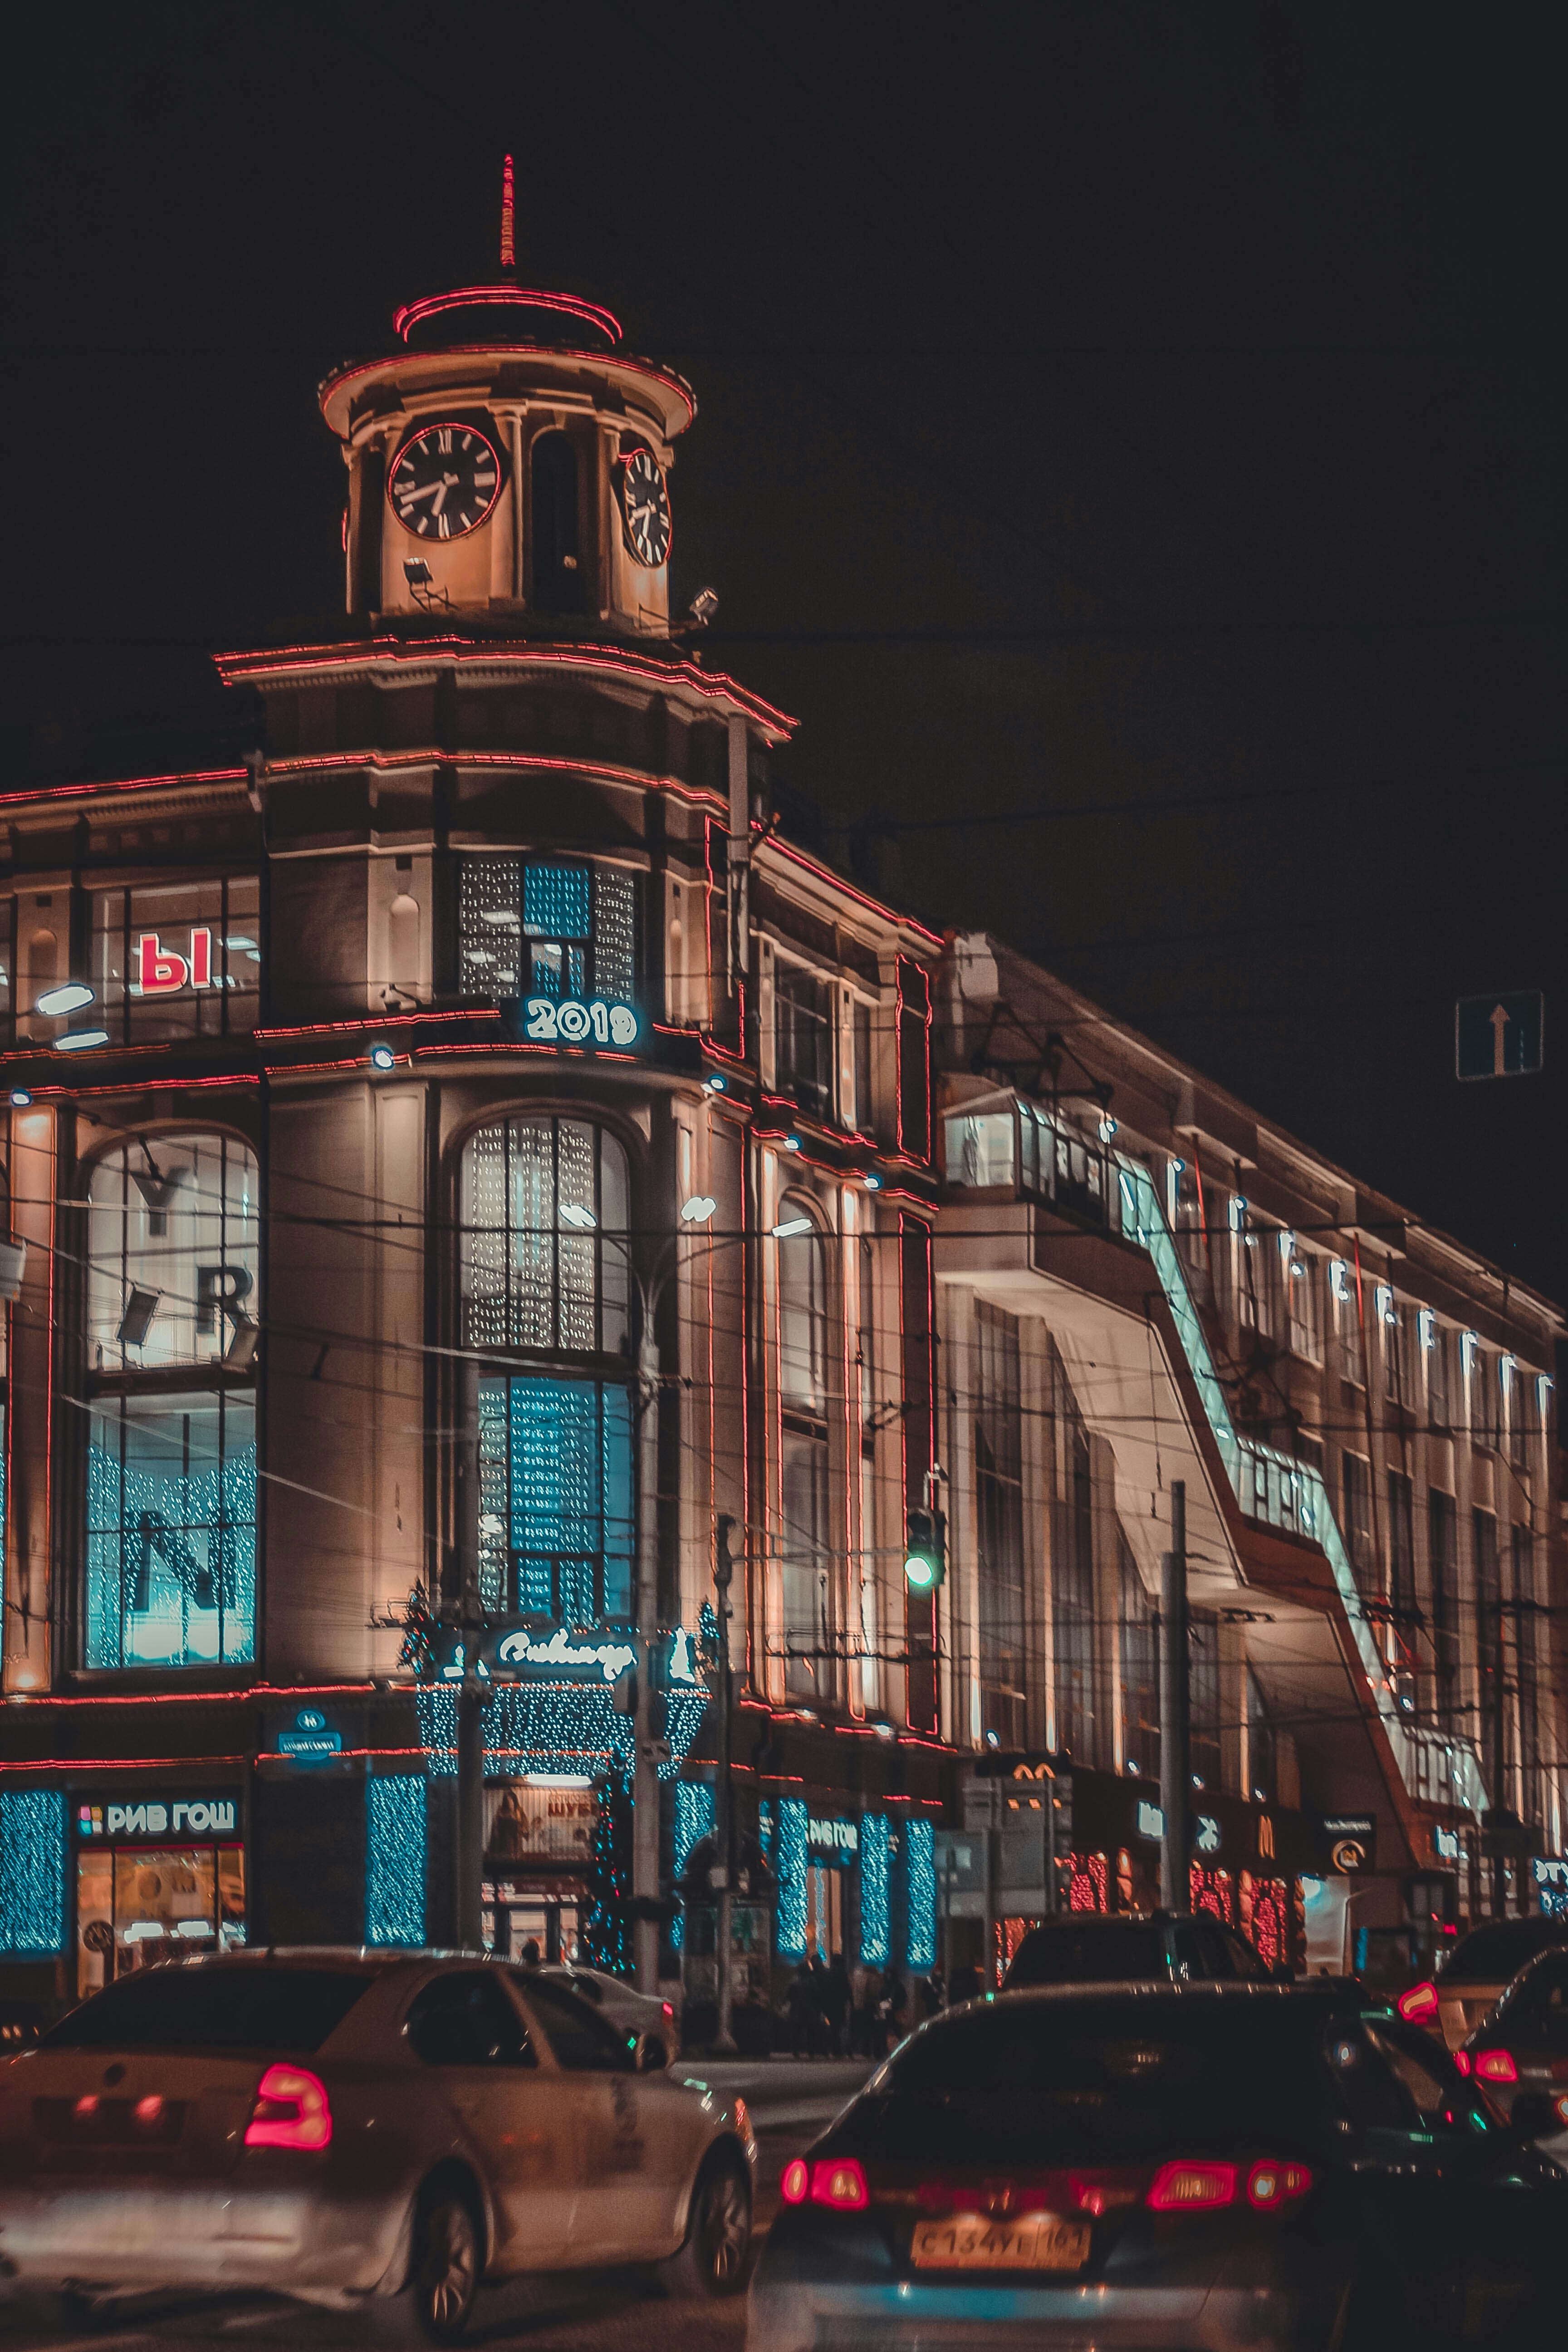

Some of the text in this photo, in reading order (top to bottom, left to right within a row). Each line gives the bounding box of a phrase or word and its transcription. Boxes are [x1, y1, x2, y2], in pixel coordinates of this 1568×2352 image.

[527, 999, 637, 1044] 2019
[107, 1801, 235, 1833] РИВ ГОШ
